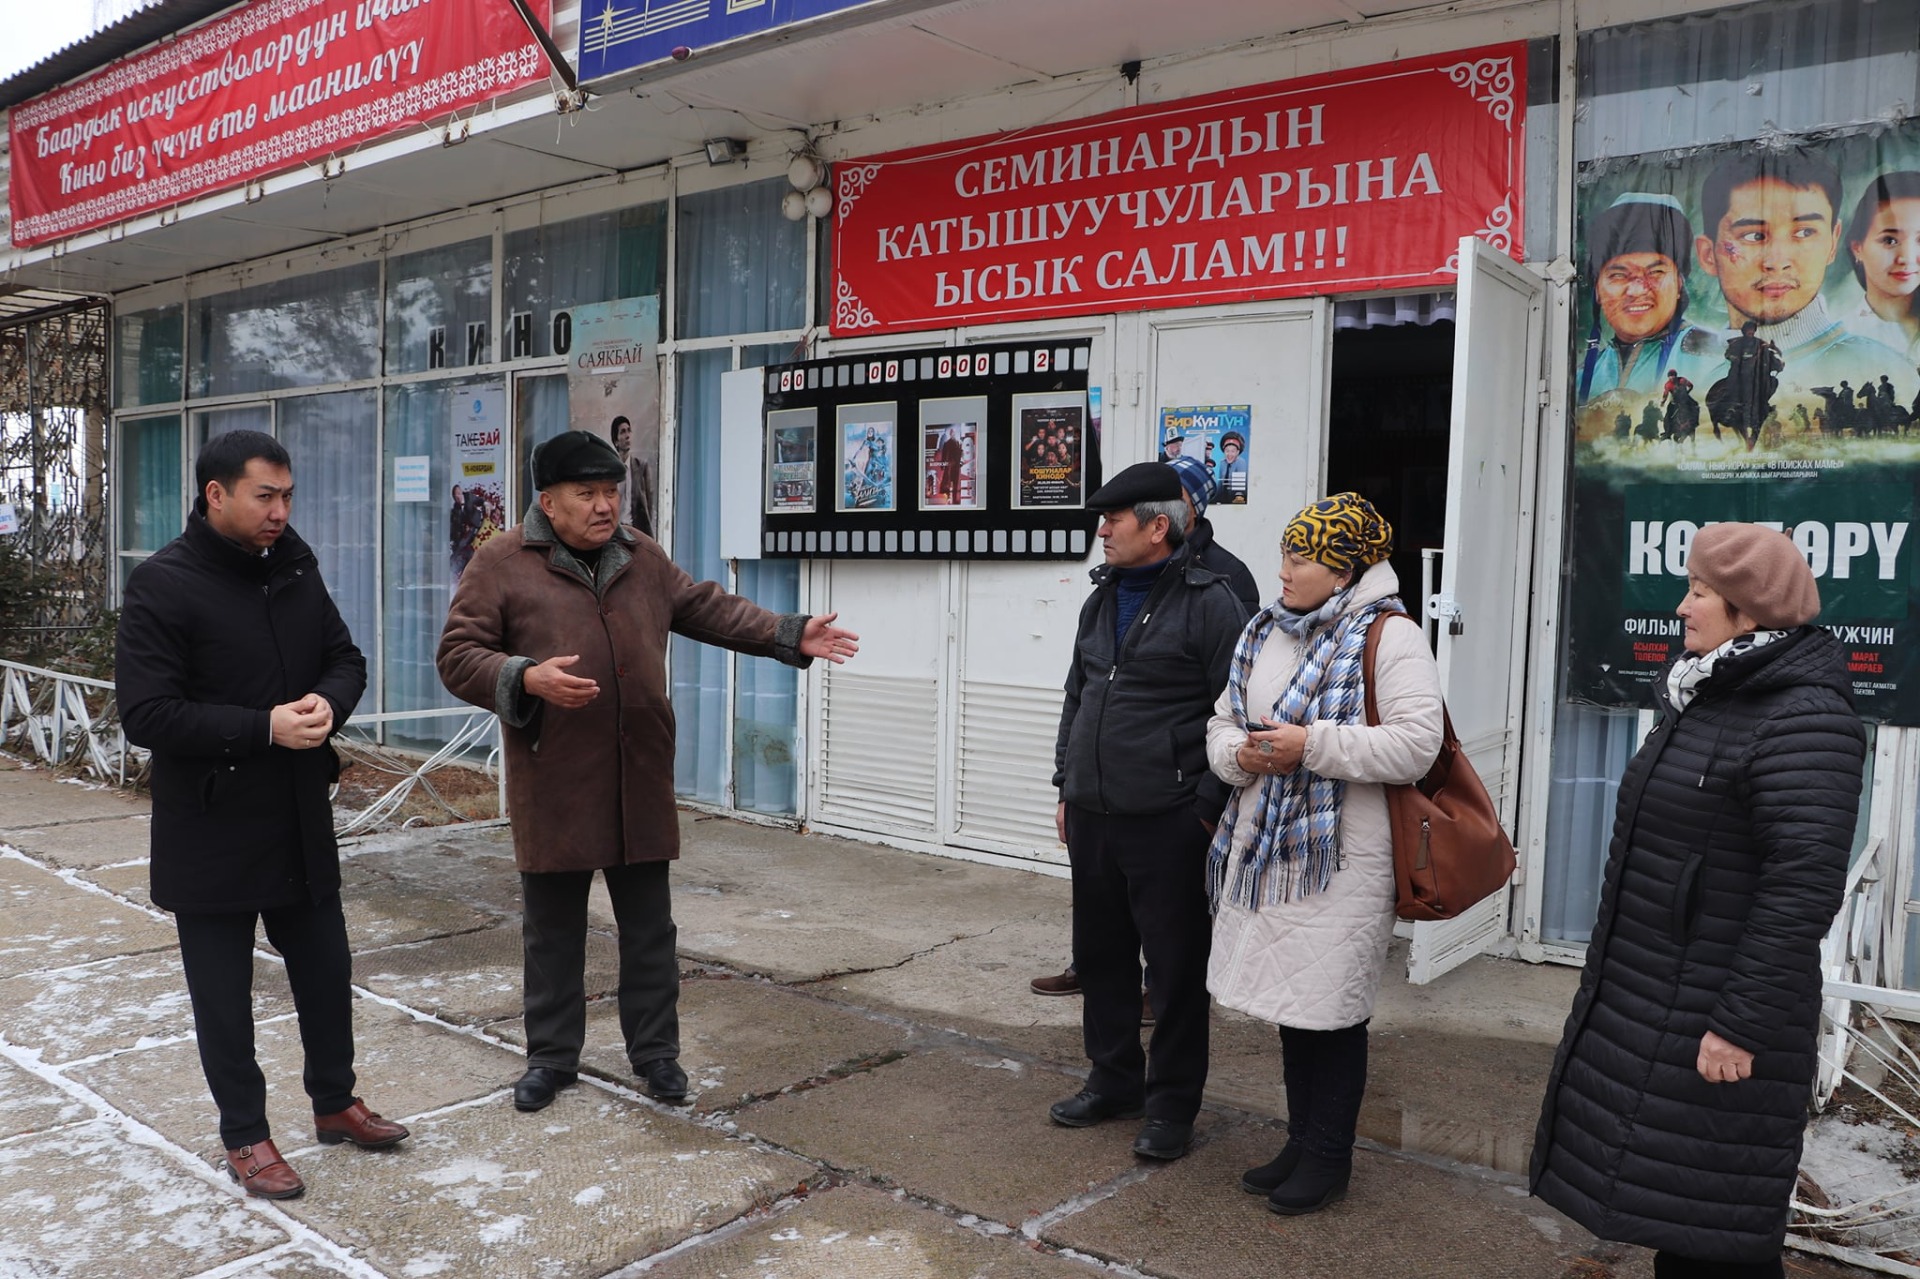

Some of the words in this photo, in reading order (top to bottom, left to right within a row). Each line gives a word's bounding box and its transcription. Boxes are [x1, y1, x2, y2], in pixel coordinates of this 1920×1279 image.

[60, 156, 105, 194] Кино
[110, 140, 145, 179] биз
[207, 103, 257, 142] өтө
[955, 104, 1325, 198] СЕМИНАРДЫН
[877, 152, 1443, 262] КАТЫШУУЧУЛАРЫНА
[933, 256, 1083, 308] ЫСЫК
[1095, 226, 1348, 289] САЛАМ!!!
[429, 312, 571, 369] КИНО
[578, 343, 643, 368] САЯКБАЙ
[1624, 617, 1681, 637] ФИЛЬМ
[1824, 625, 1894, 645] УЖЧИН
[1851, 652, 1880, 662] МАРАТ
